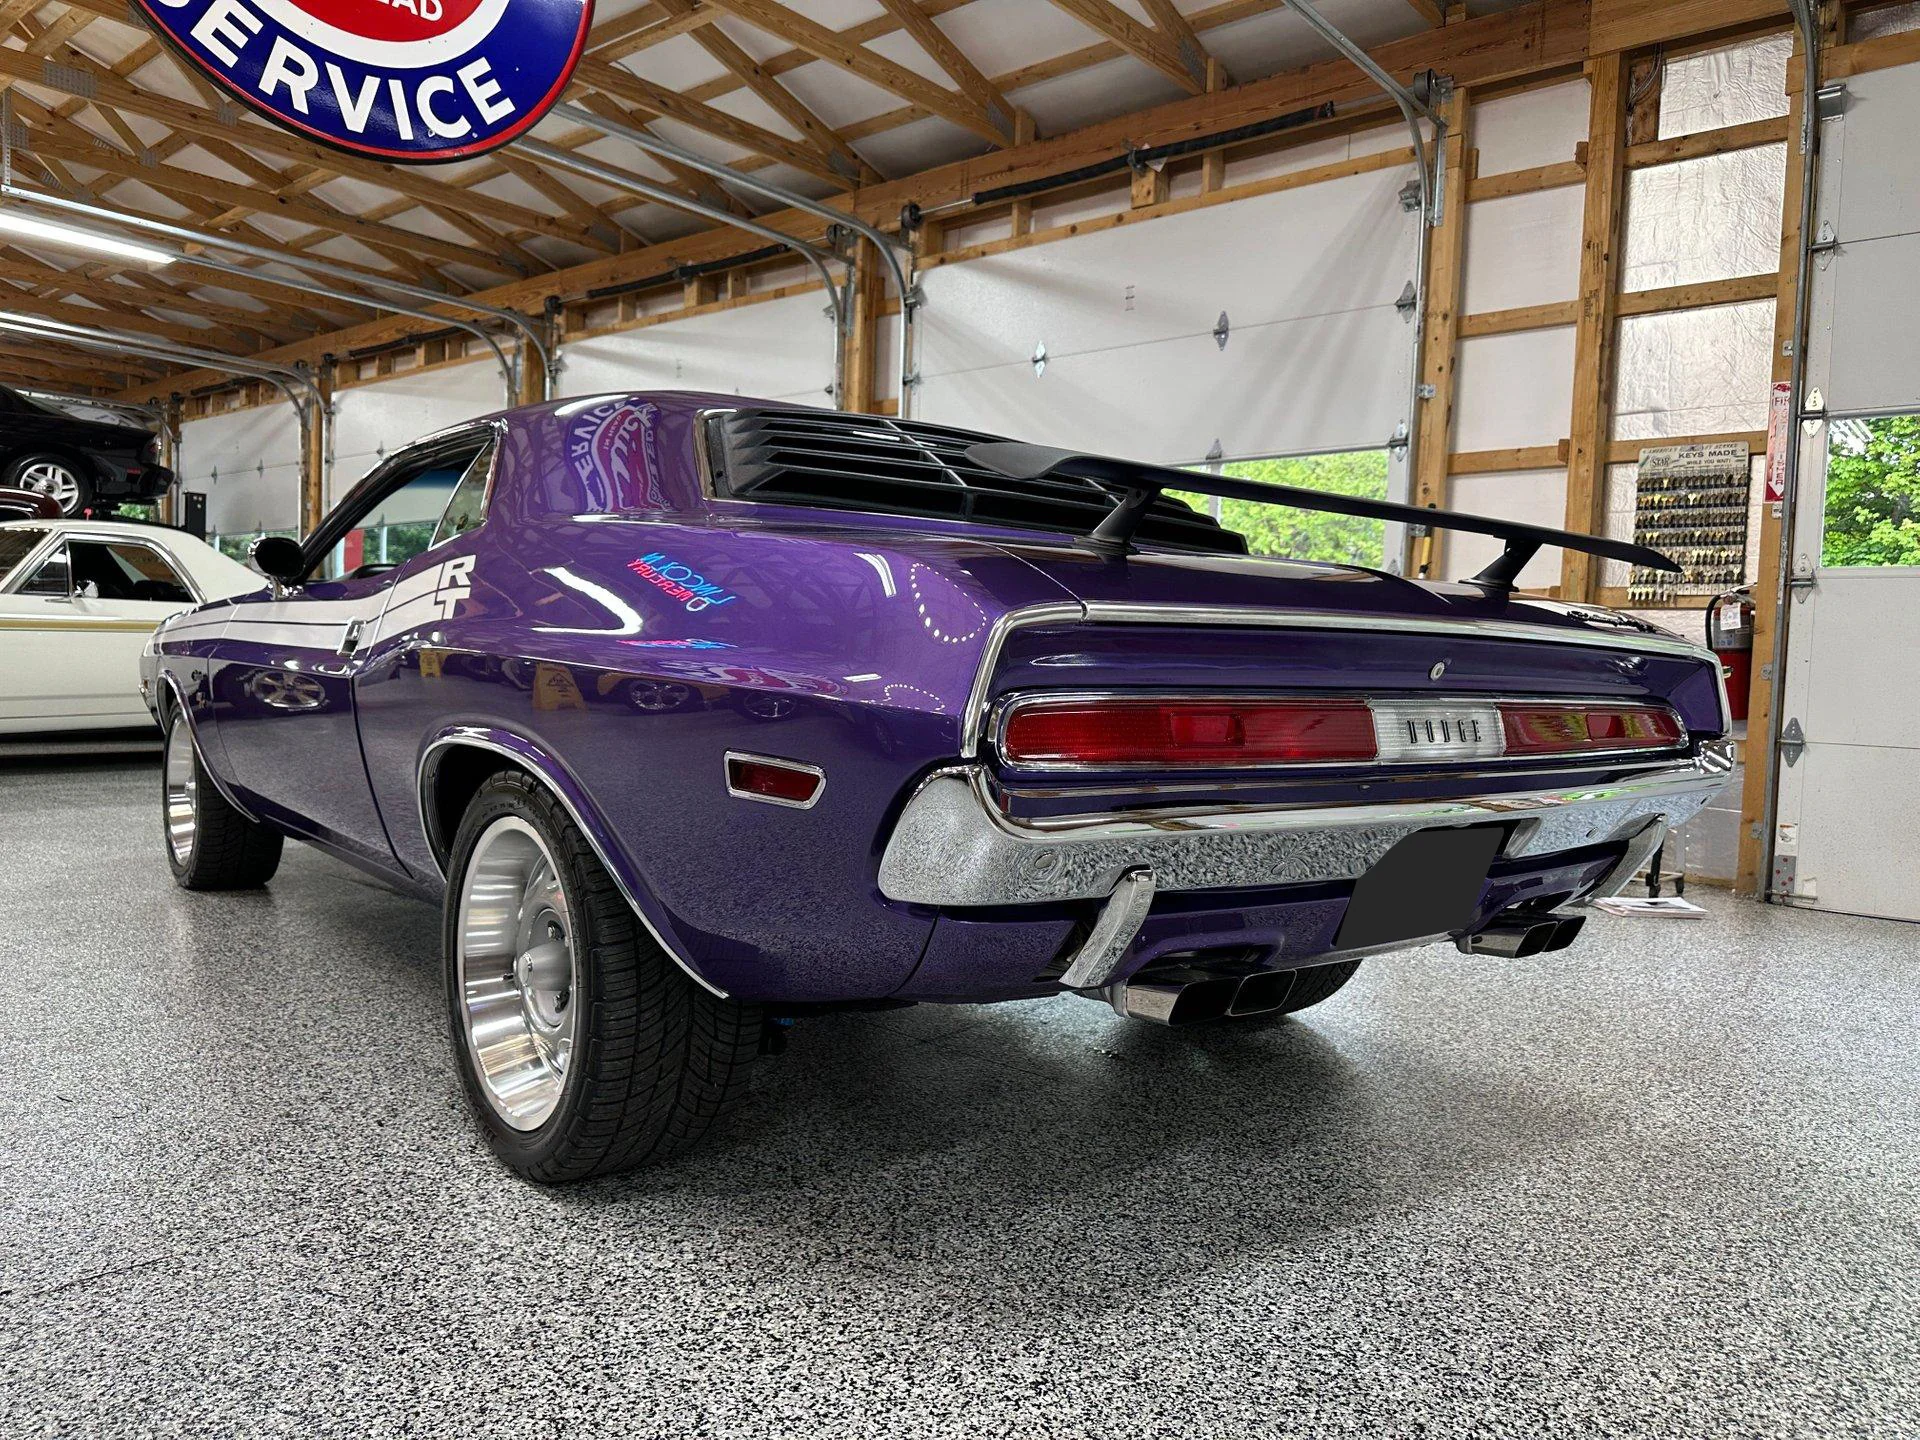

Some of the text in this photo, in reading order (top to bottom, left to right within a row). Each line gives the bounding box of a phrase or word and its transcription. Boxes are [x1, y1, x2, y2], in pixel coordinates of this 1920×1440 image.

[158, 0, 516, 140] ERVICE
[1678, 449, 1737, 459] KEYS MADE
[1406, 719, 1482, 744] DODGE
